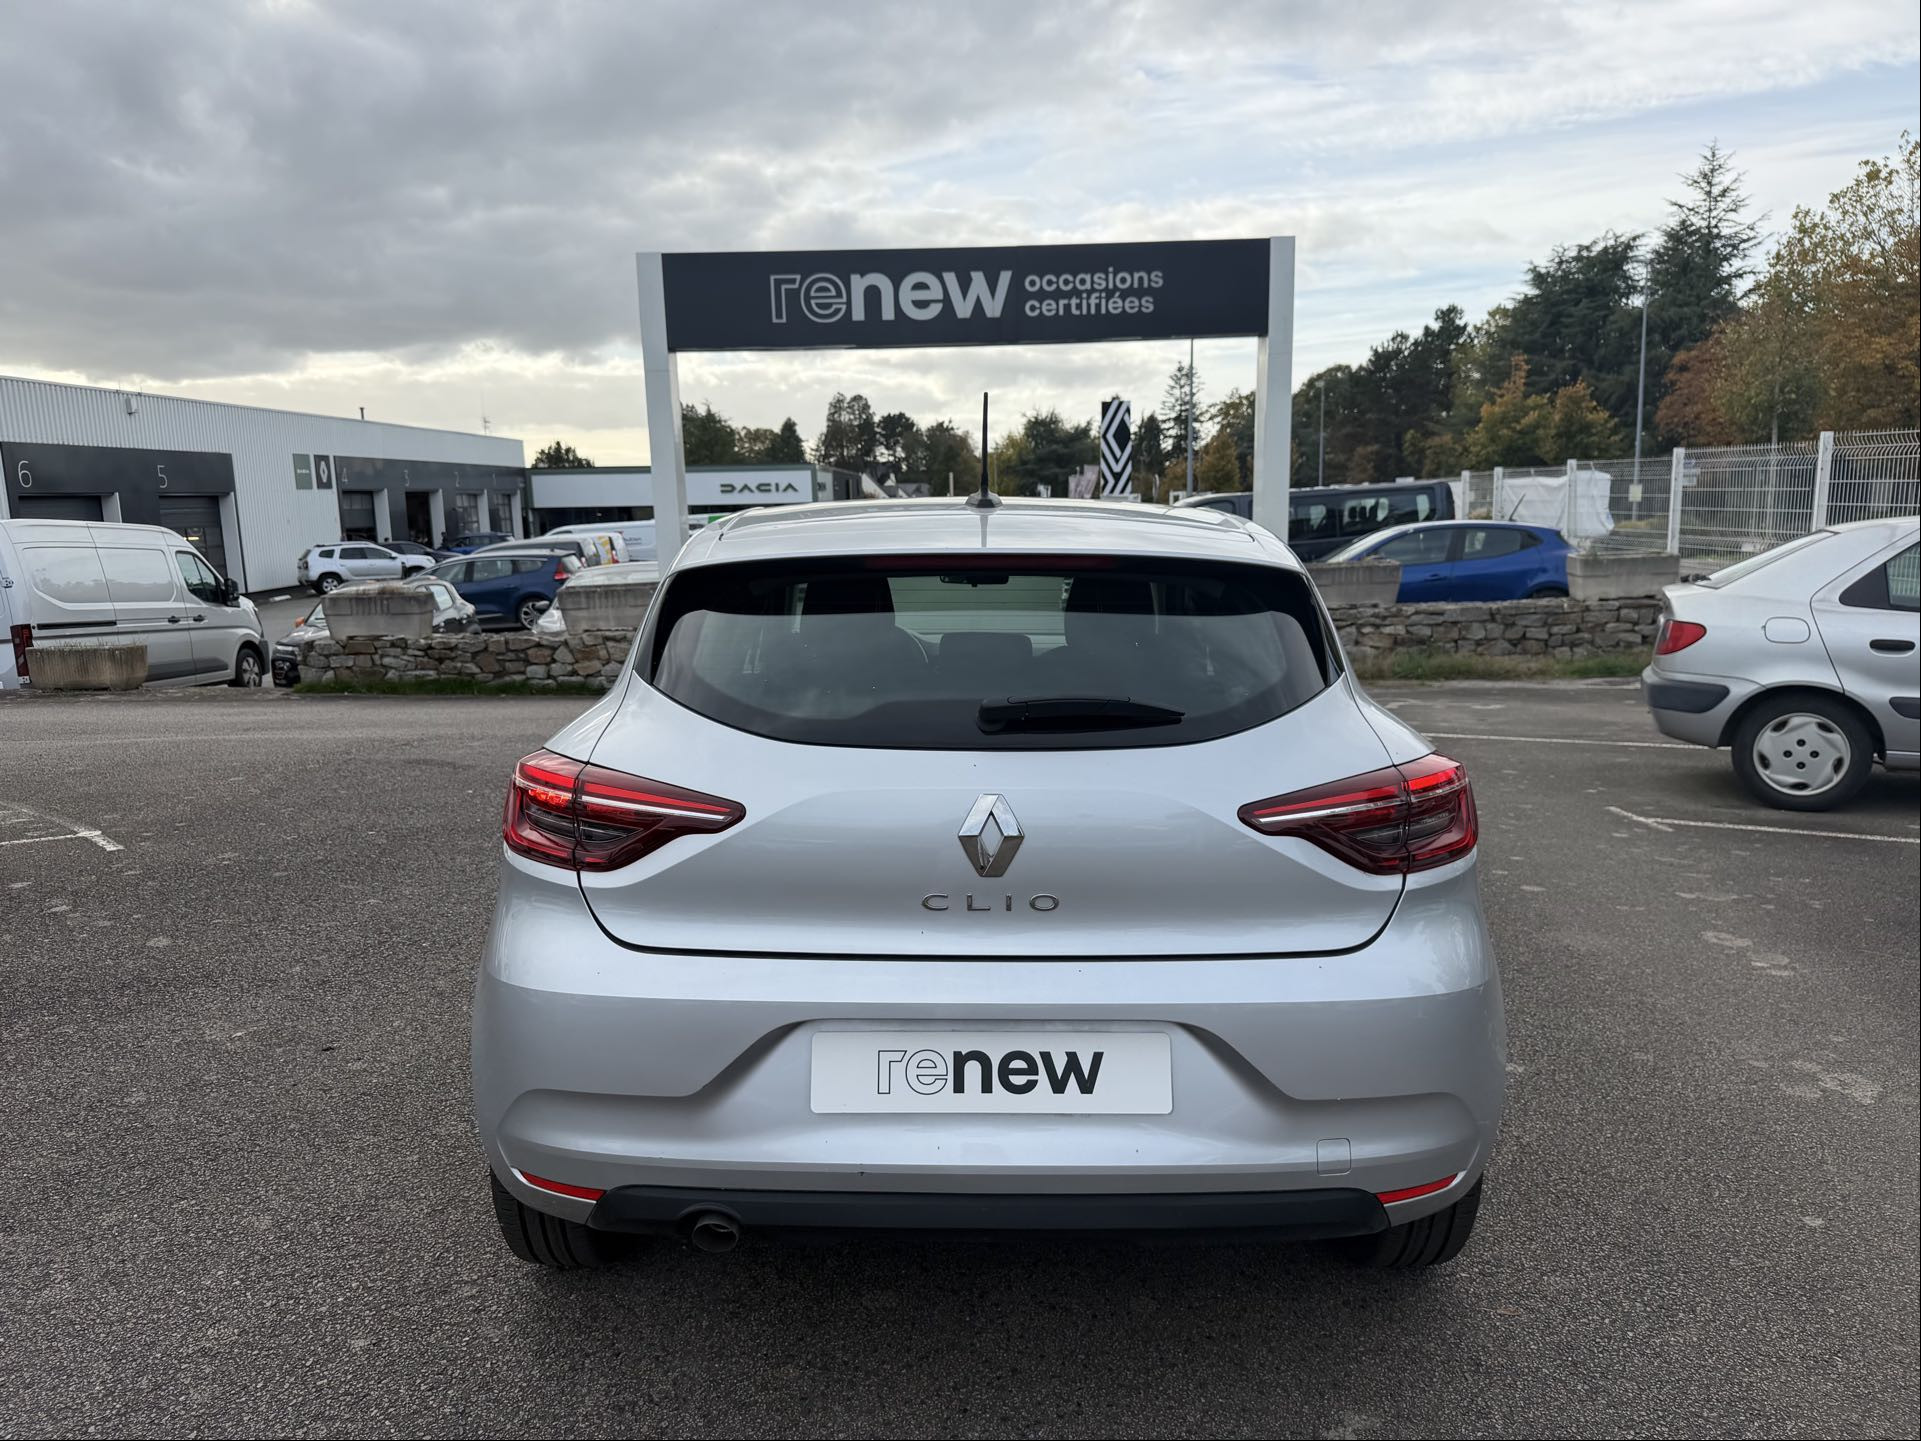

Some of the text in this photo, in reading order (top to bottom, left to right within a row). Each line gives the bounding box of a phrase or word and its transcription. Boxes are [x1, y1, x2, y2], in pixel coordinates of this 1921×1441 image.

[1024, 267, 1164, 292] occasions
[769, 270, 1013, 324] renew
[1024, 291, 1154, 317] certifiées
[18, 460, 32, 488] 6
[157, 465, 168, 488] 5
[720, 482, 799, 494] DACIA
[921, 893, 1060, 912] CLIO
[877, 1049, 1105, 1096] renew
